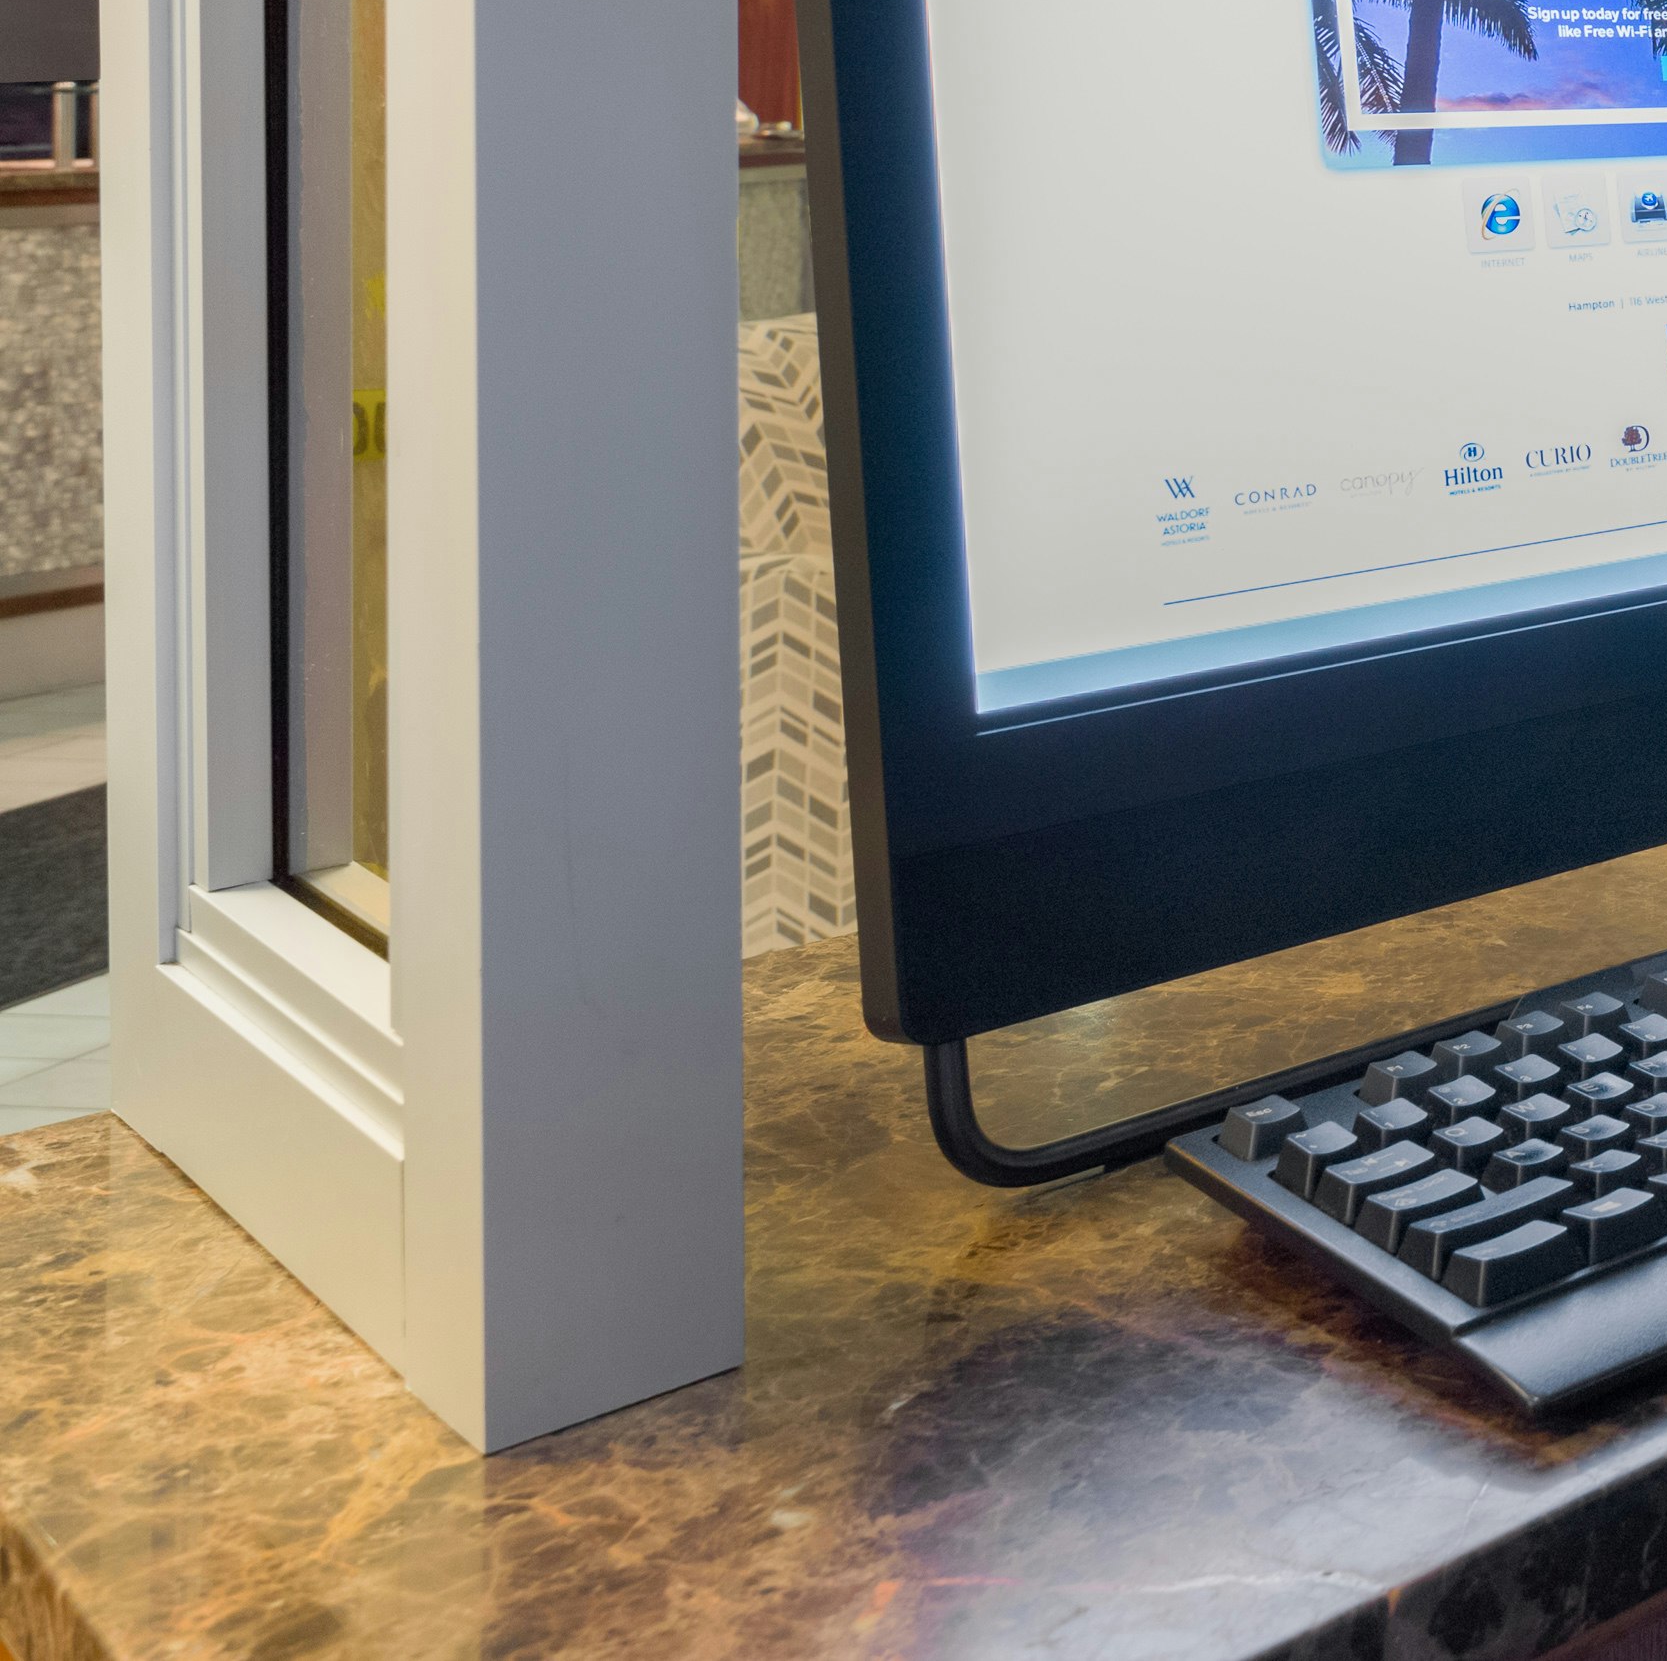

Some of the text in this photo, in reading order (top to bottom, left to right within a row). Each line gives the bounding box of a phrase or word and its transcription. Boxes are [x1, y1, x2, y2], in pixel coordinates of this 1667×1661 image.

[1527, 6, 1560, 22] Sign
[1561, 9, 1580, 23] up
[1581, 7, 1619, 23] today
[1621, 7, 1641, 21] for
[1558, 25, 1581, 38] like
[1583, 25, 1615, 38] Free
[1615, 25, 1653, 38] Wi-Fi
[1568, 299, 1615, 312] Hampton
[1525, 443, 1592, 470] CURIO
[1444, 464, 1504, 487] Hilton
[1234, 483, 1318, 506] CONRAD
[1156, 507, 1210, 522] WALDORF
[1163, 522, 1207, 536] ASTORIA
[1244, 1107, 1273, 1118] Esc
